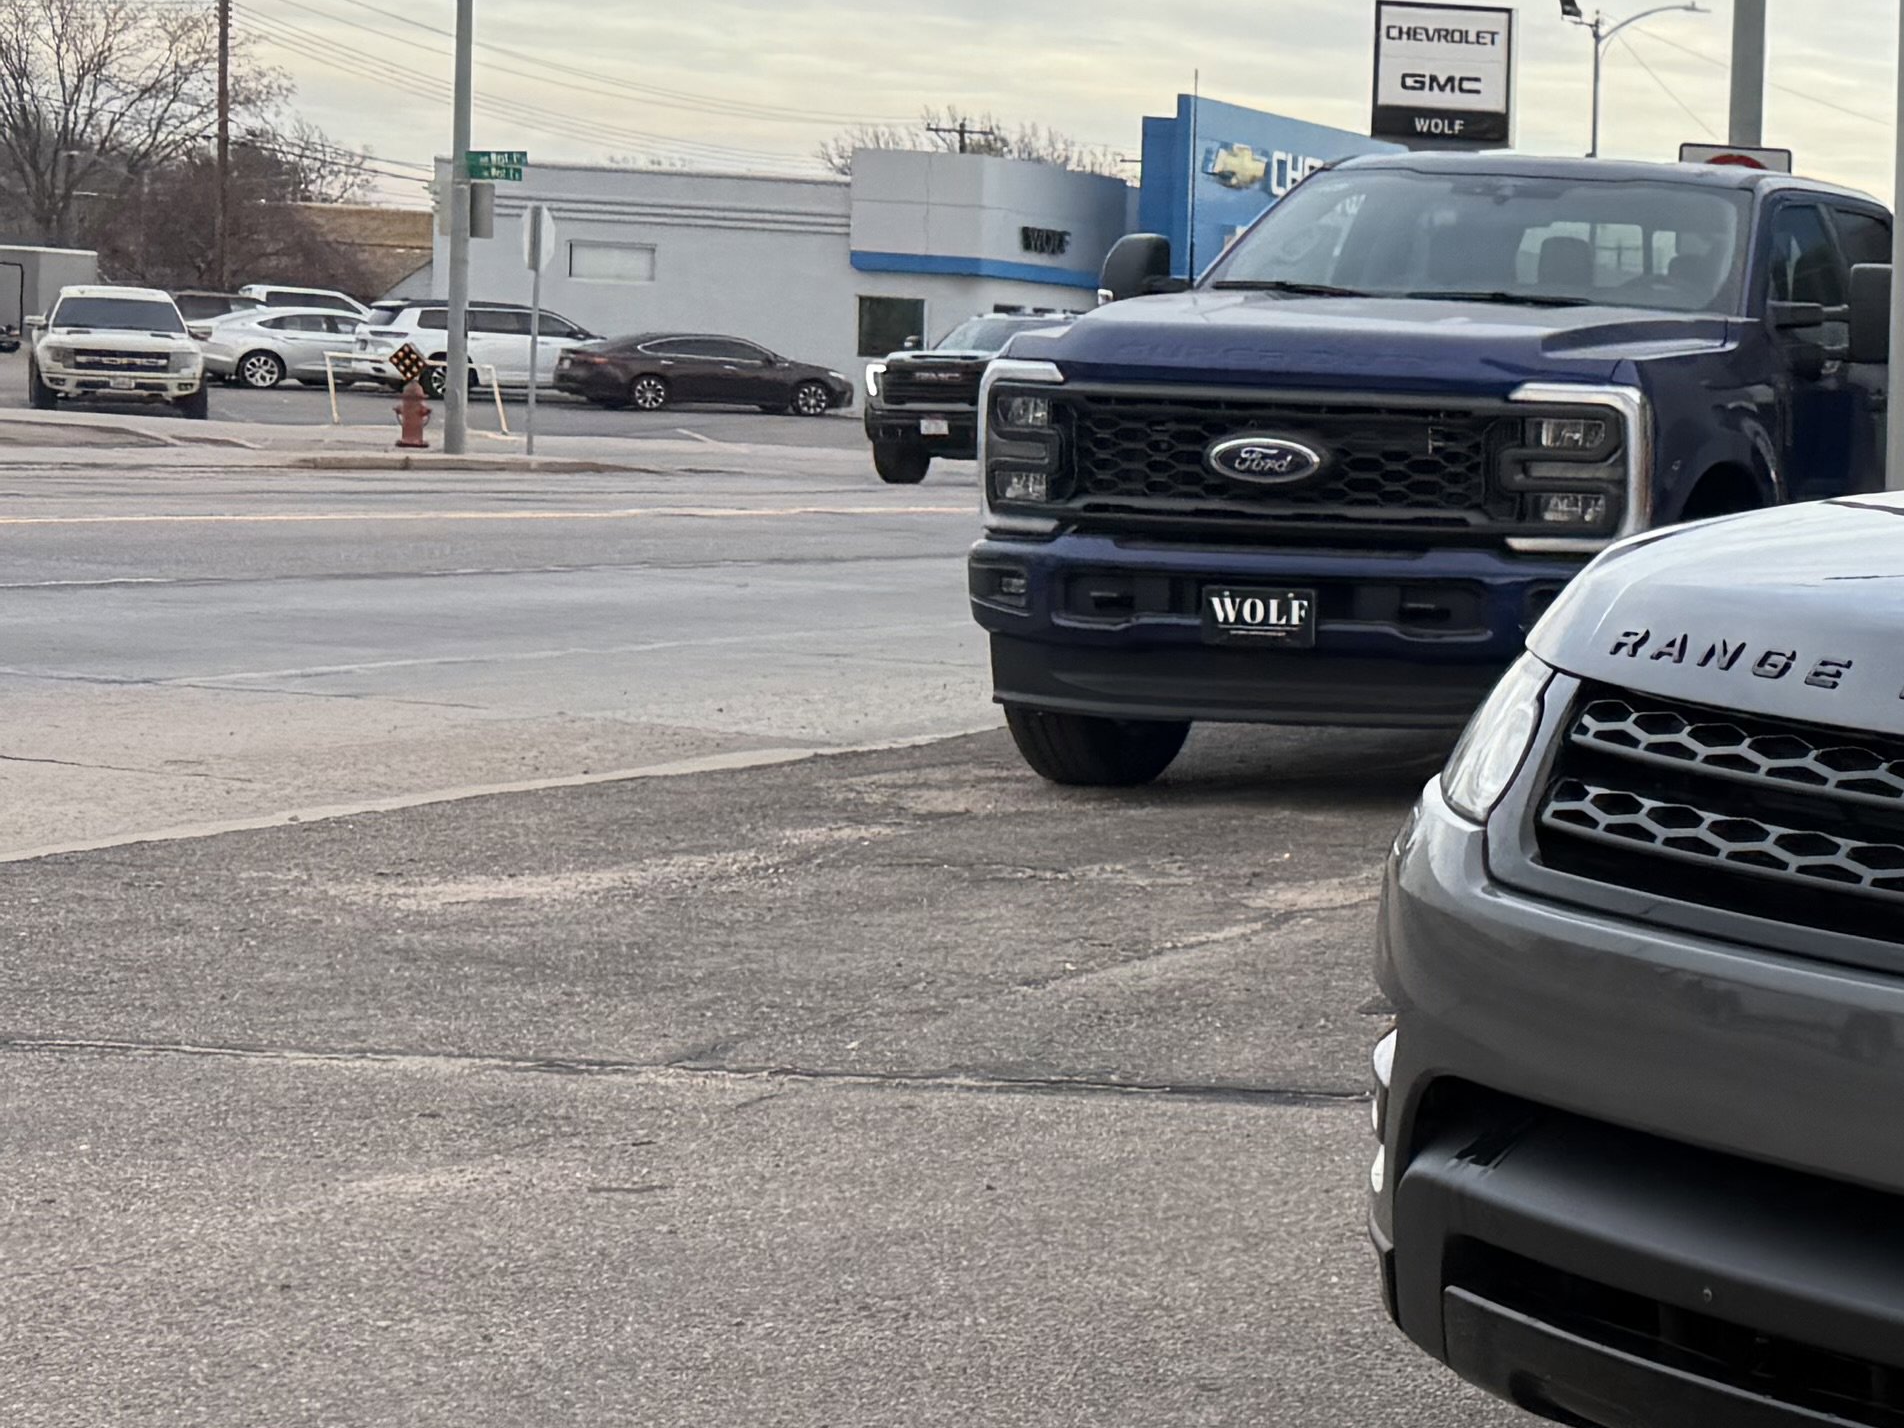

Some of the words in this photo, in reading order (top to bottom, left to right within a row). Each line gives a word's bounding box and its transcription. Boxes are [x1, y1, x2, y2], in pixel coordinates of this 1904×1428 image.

[1386, 25, 1500, 46] CHEVROLET
[1400, 73, 1482, 94] GMC
[1414, 117, 1464, 134] WOLF
[1234, 447, 1292, 471] Ford
[1209, 597, 1309, 625] WOLF
[1609, 627, 1853, 690] RANGE
